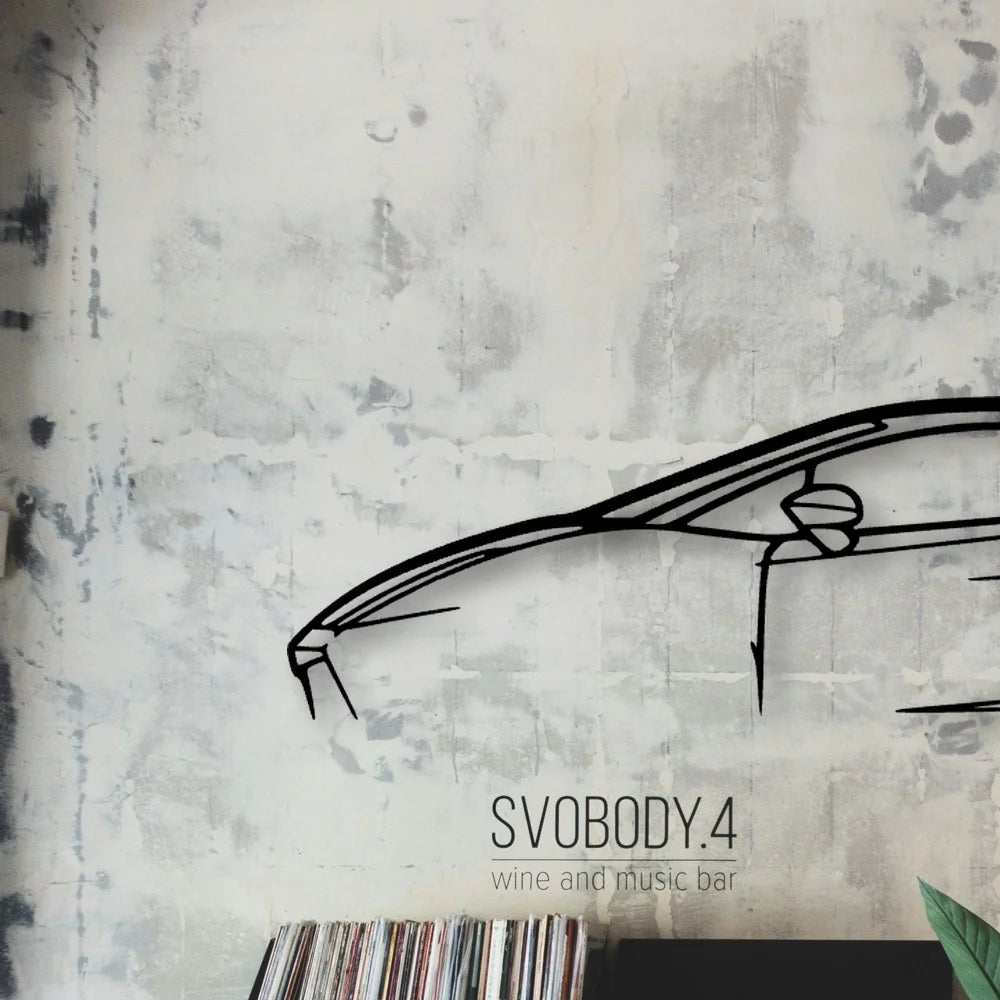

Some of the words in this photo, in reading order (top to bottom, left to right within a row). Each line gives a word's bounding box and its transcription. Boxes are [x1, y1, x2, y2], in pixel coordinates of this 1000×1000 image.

[491, 795, 738, 849] SVOBODY.4
[491, 867, 550, 891] wine
[560, 865, 606, 891] and
[616, 867, 688, 891] music
[697, 865, 737, 891] bar
